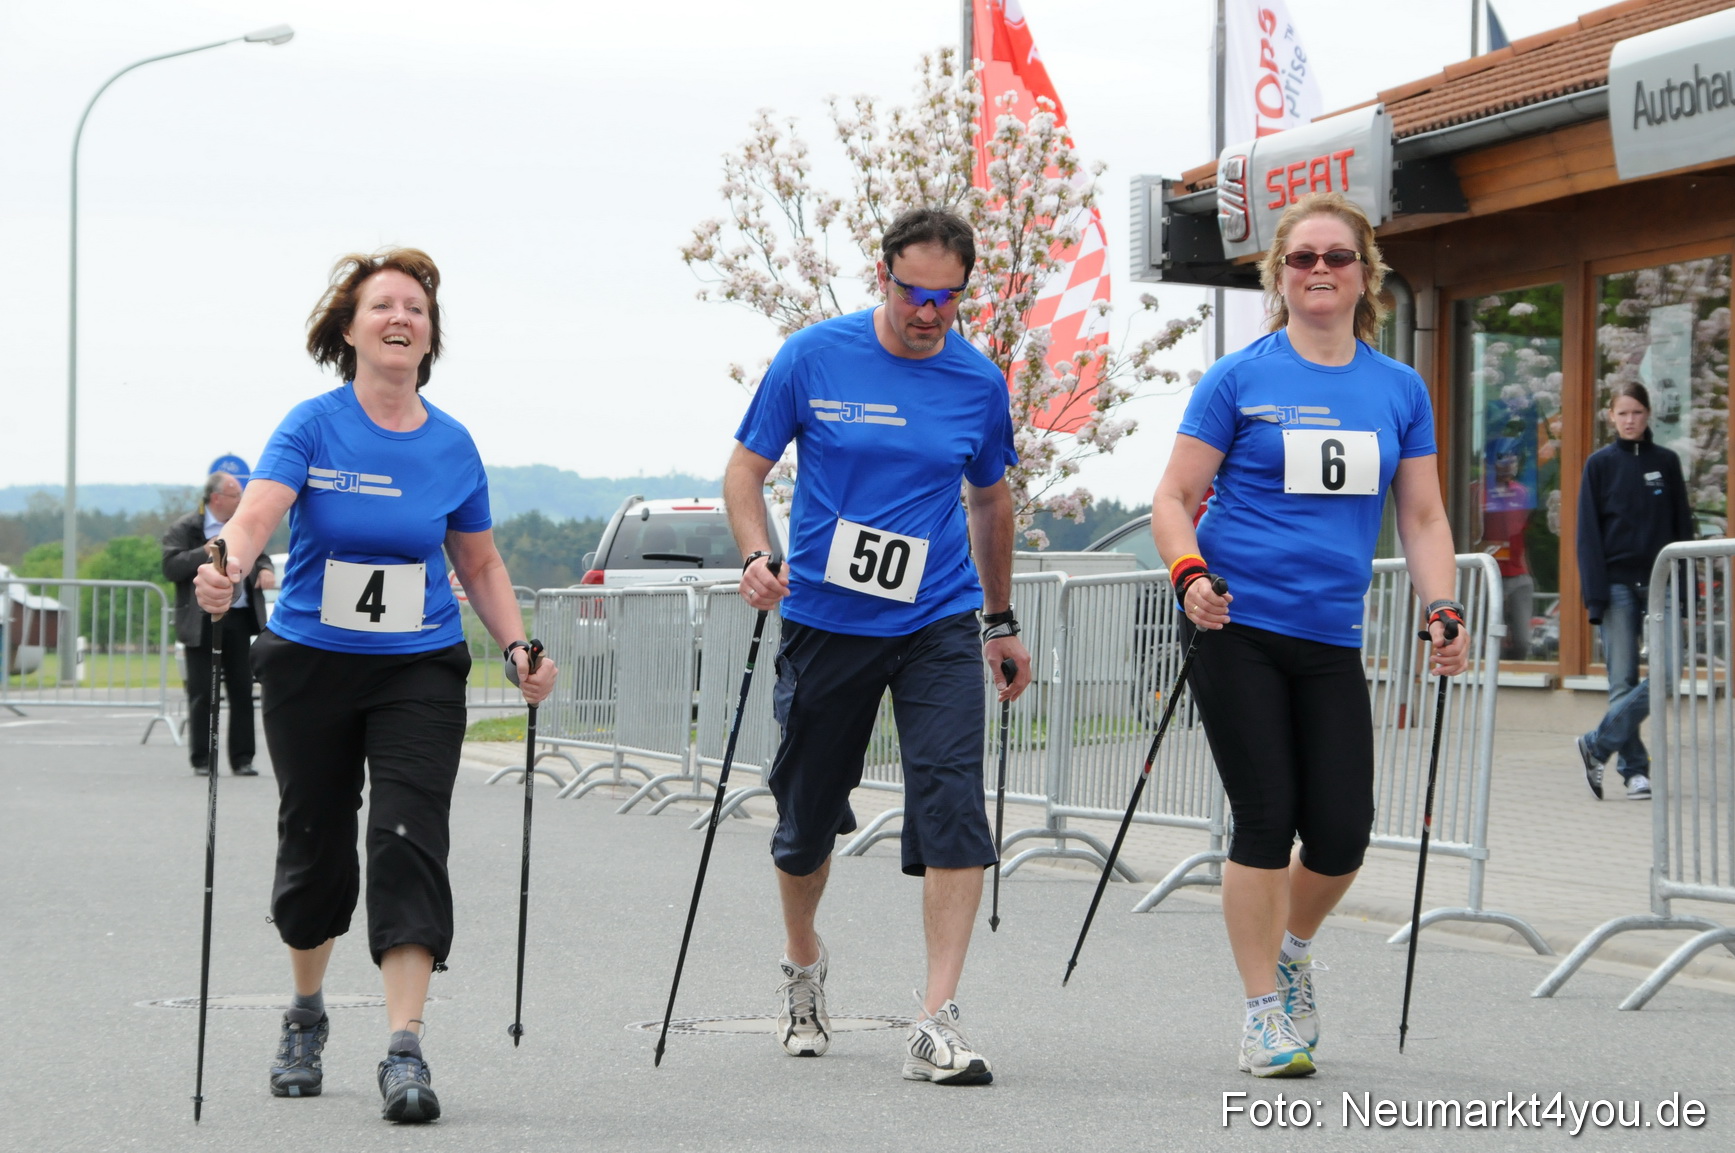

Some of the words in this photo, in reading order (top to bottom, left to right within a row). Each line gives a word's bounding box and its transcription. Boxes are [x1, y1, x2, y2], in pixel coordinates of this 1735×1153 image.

[1265, 148, 1355, 210] SEAT
[1321, 438, 1346, 491] 6
[849, 530, 911, 590] 50
[355, 569, 386, 623] 4
